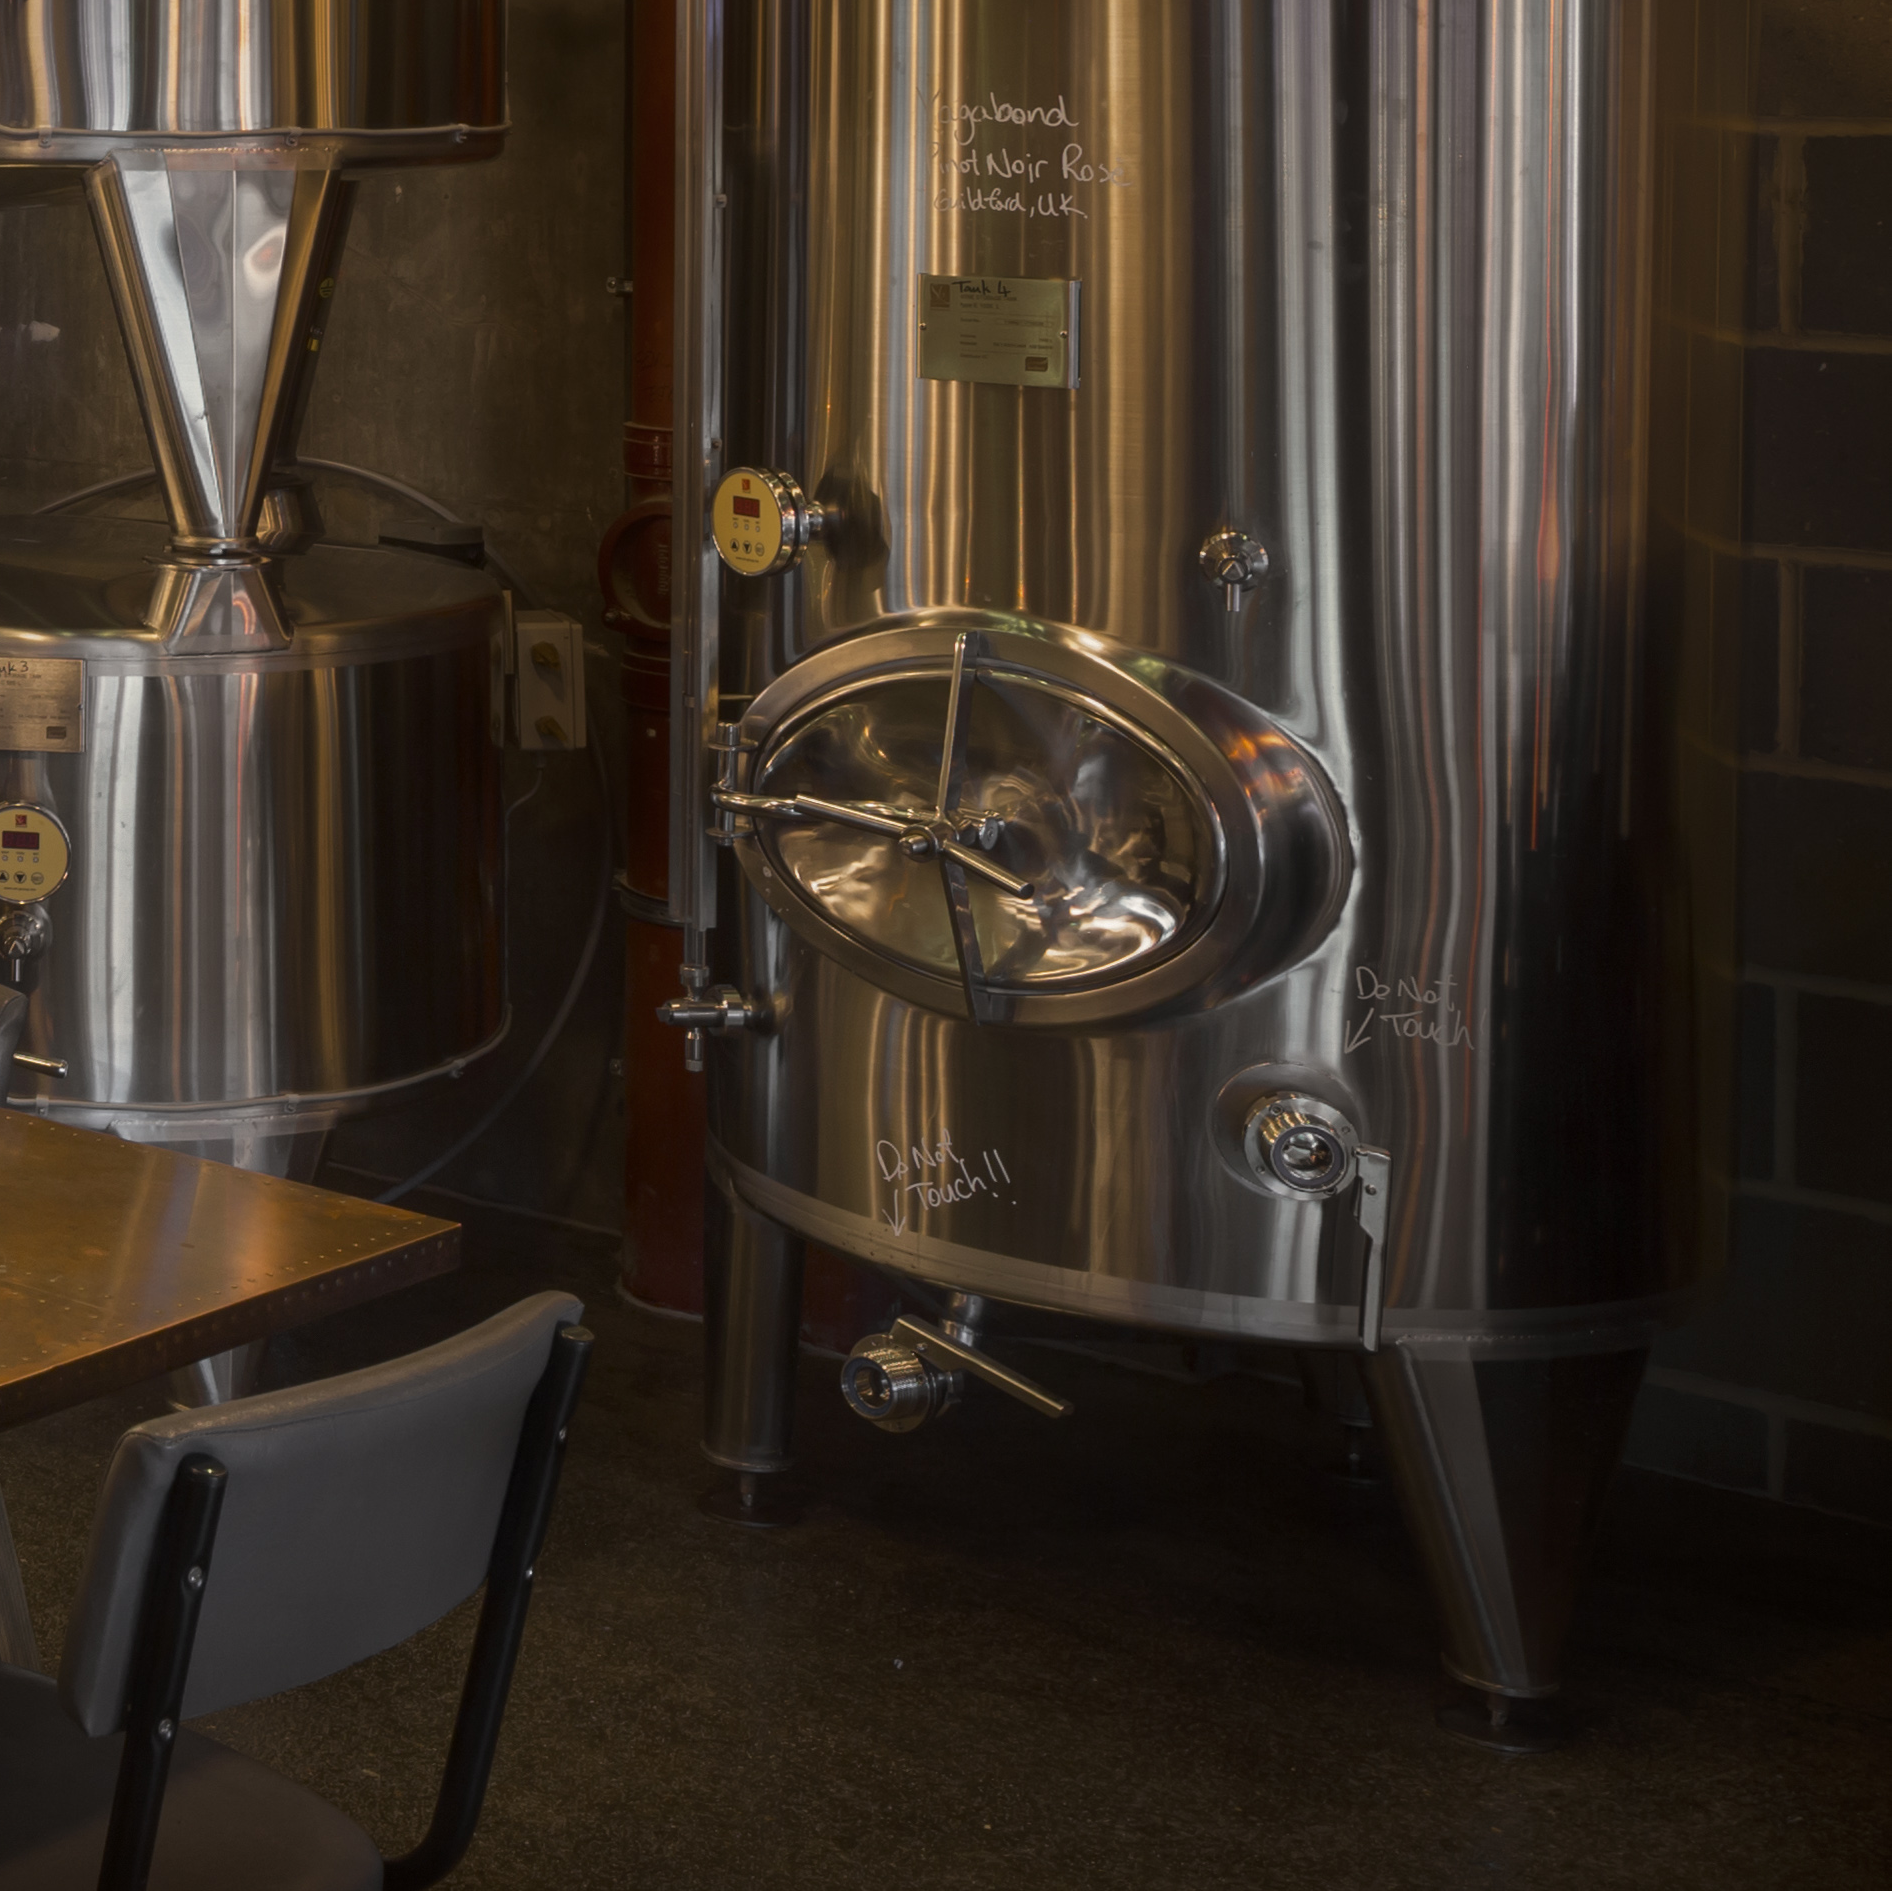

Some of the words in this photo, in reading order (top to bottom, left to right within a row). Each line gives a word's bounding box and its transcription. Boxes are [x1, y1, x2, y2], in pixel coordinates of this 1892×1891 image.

[987, 153, 1049, 183] Noir
[952, 279, 991, 296] Tank
[998, 280, 1011, 297] 4
[20, 660, 29, 673] 3
[1356, 965, 1391, 1002] Do
[1396, 974, 1459, 1011] Not
[876, 1140, 910, 1183] Do
[913, 1127, 960, 1171] Not
